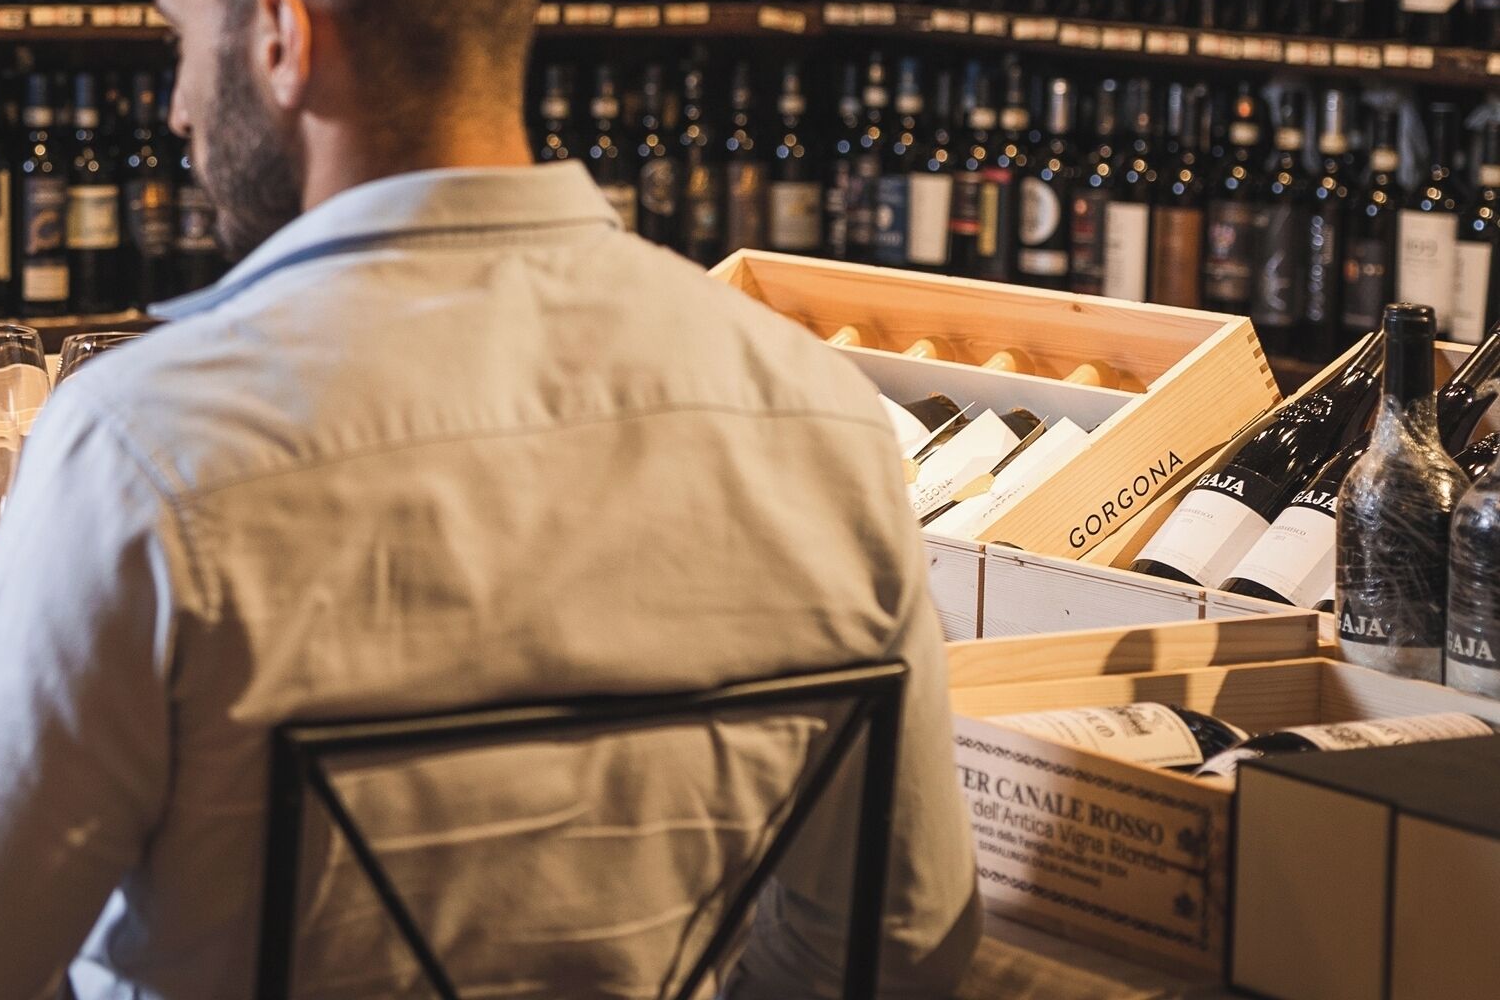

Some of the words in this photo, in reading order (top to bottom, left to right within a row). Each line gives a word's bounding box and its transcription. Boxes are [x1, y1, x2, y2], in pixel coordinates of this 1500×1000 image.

[912, 478, 954, 511] ORGONA
[1069, 451, 1184, 548] GORGONA
[1196, 473, 1245, 497] GAJA
[1291, 490, 1339, 513] GAJA
[1446, 630, 1497, 662] GAJA
[995, 777, 1085, 822] CANALE
[1089, 803, 1165, 847] ROSSO
[1058, 823, 1104, 855] Vigna
